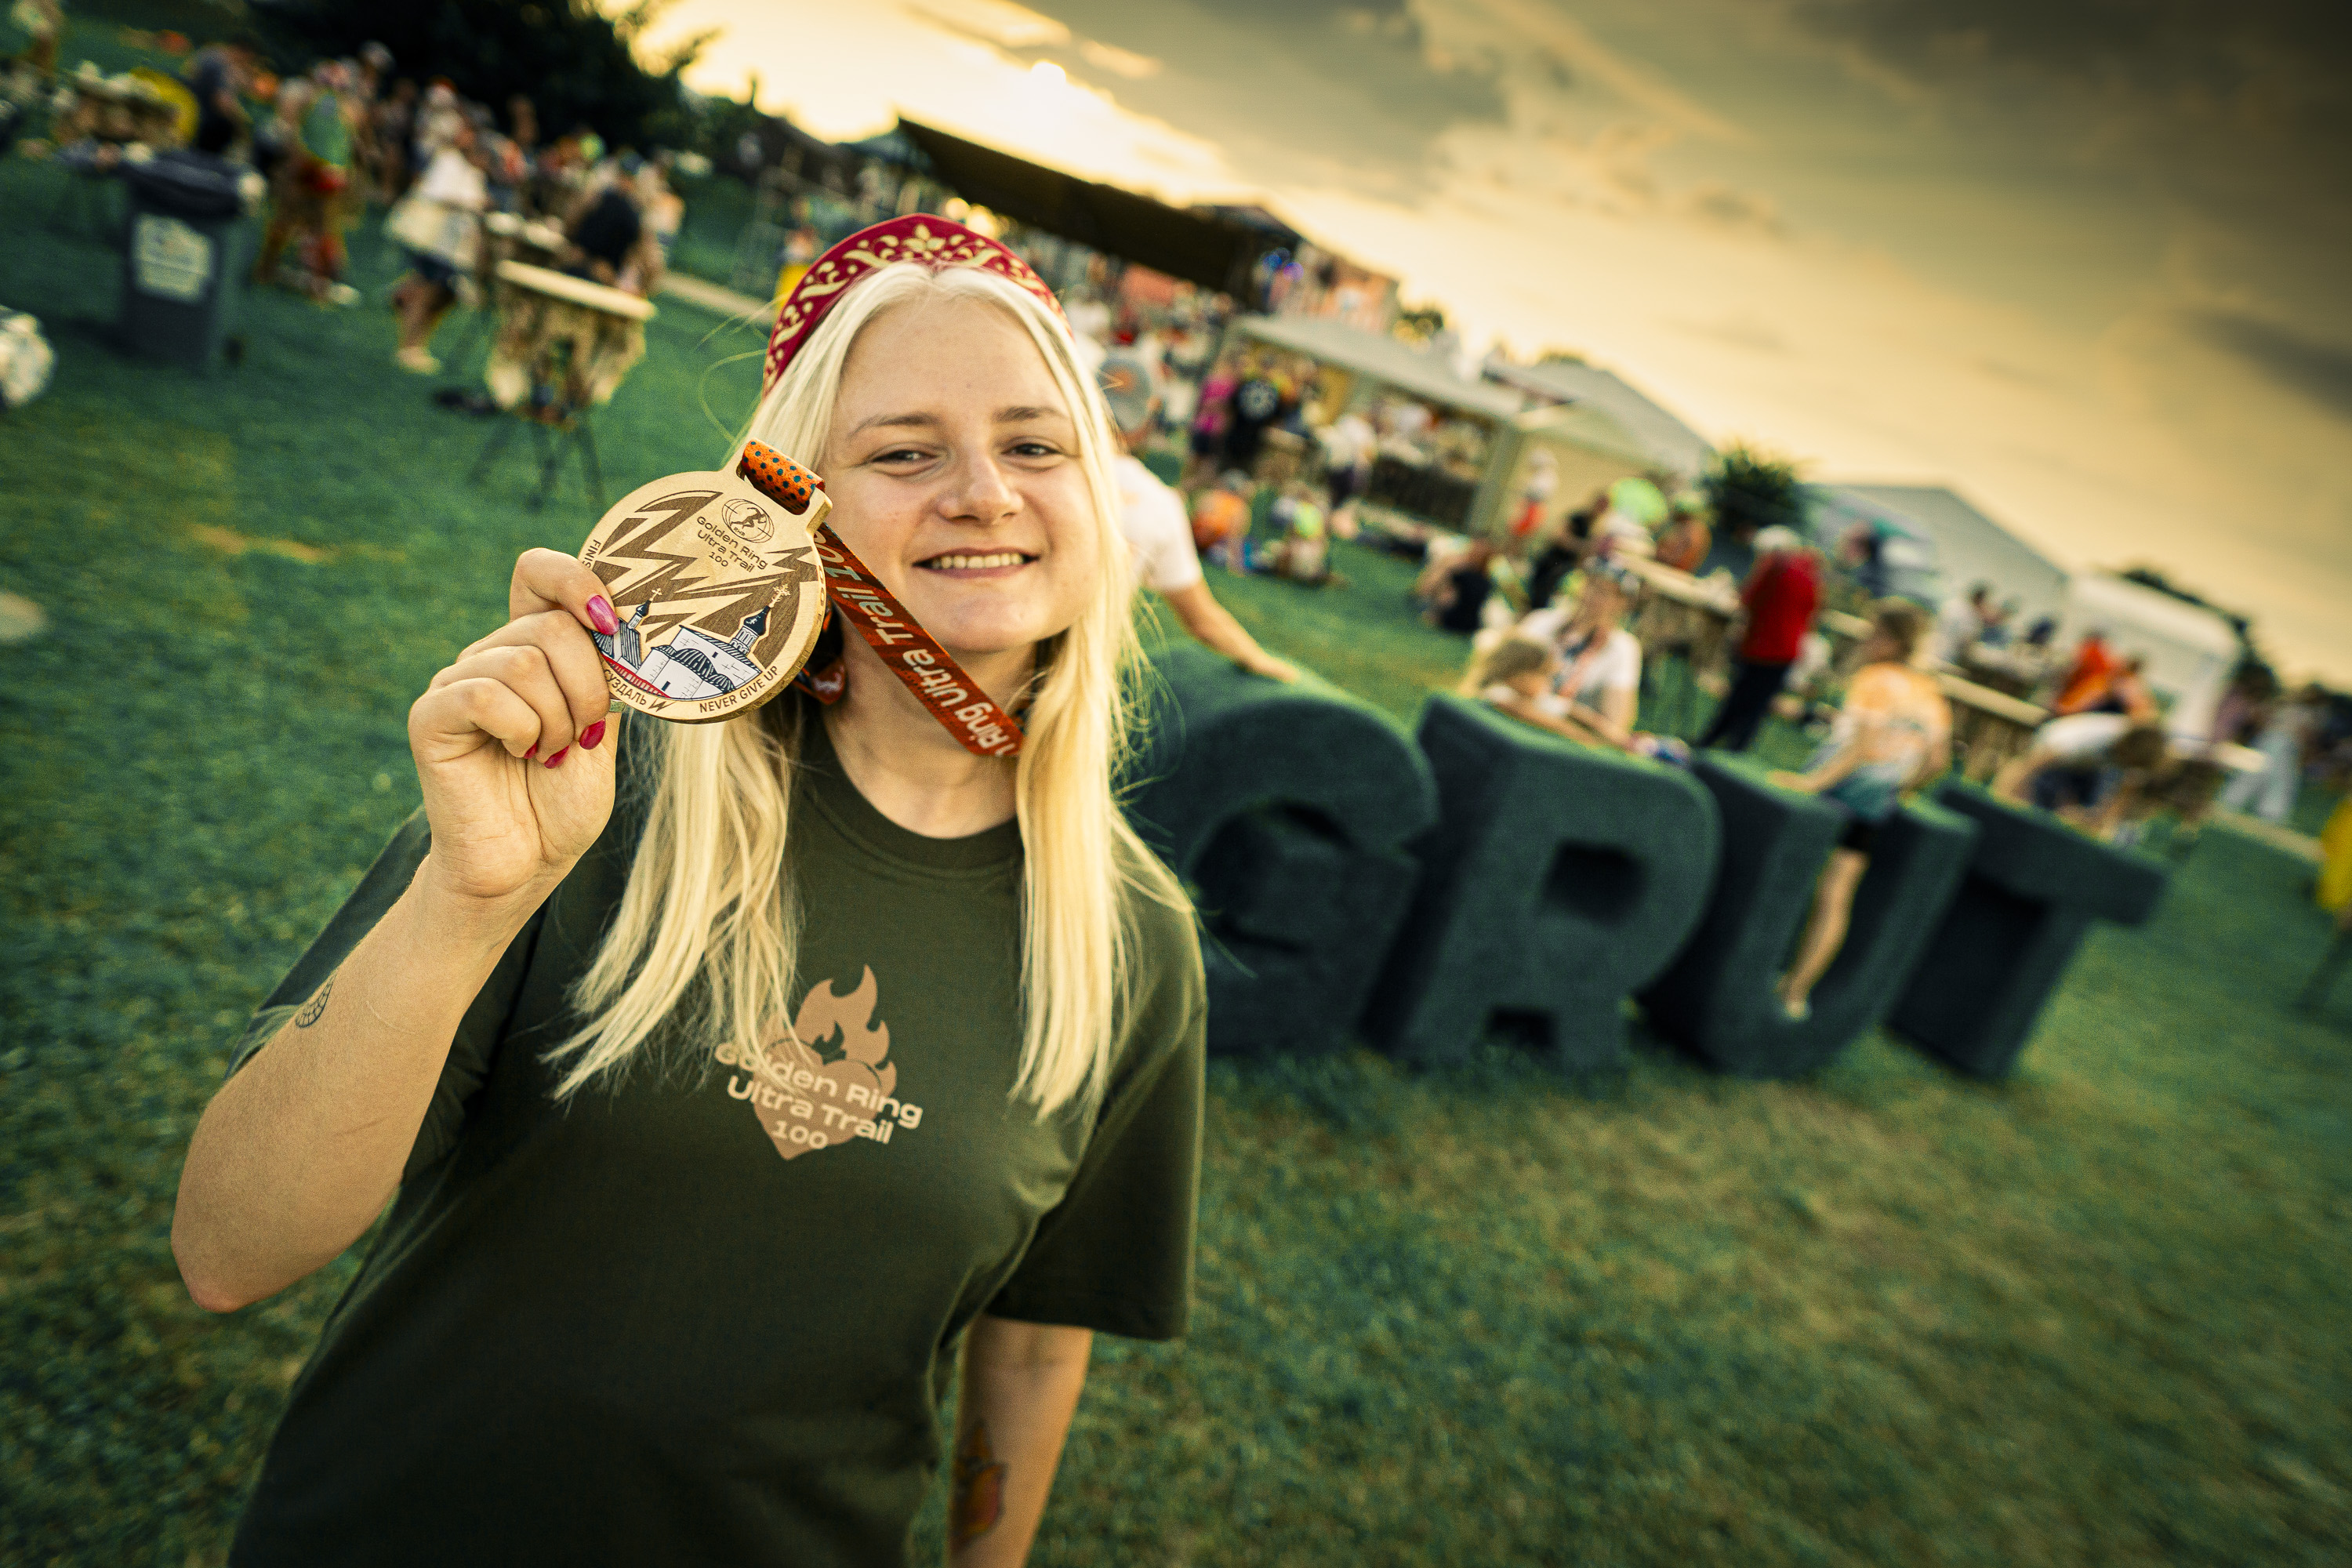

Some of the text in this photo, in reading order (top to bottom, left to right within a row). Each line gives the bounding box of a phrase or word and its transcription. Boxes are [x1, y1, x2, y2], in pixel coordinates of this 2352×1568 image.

[582, 539, 601, 568] FINIS
[697, 516, 768, 570] Golden Ring
[697, 529, 755, 572] Ultra Trail
[709, 551, 728, 567] 100
[835, 586, 914, 645] Trail
[699, 666, 779, 713] NEVER GIVE UP
[902, 648, 968, 707] Ultra
[954, 702, 1009, 749] Ring
[1141, 649, 2168, 1082] GRUT
[727, 1075, 895, 1145] Ultra Trail
[846, 1083, 924, 1130] Ring
[771, 1120, 828, 1149] 100
